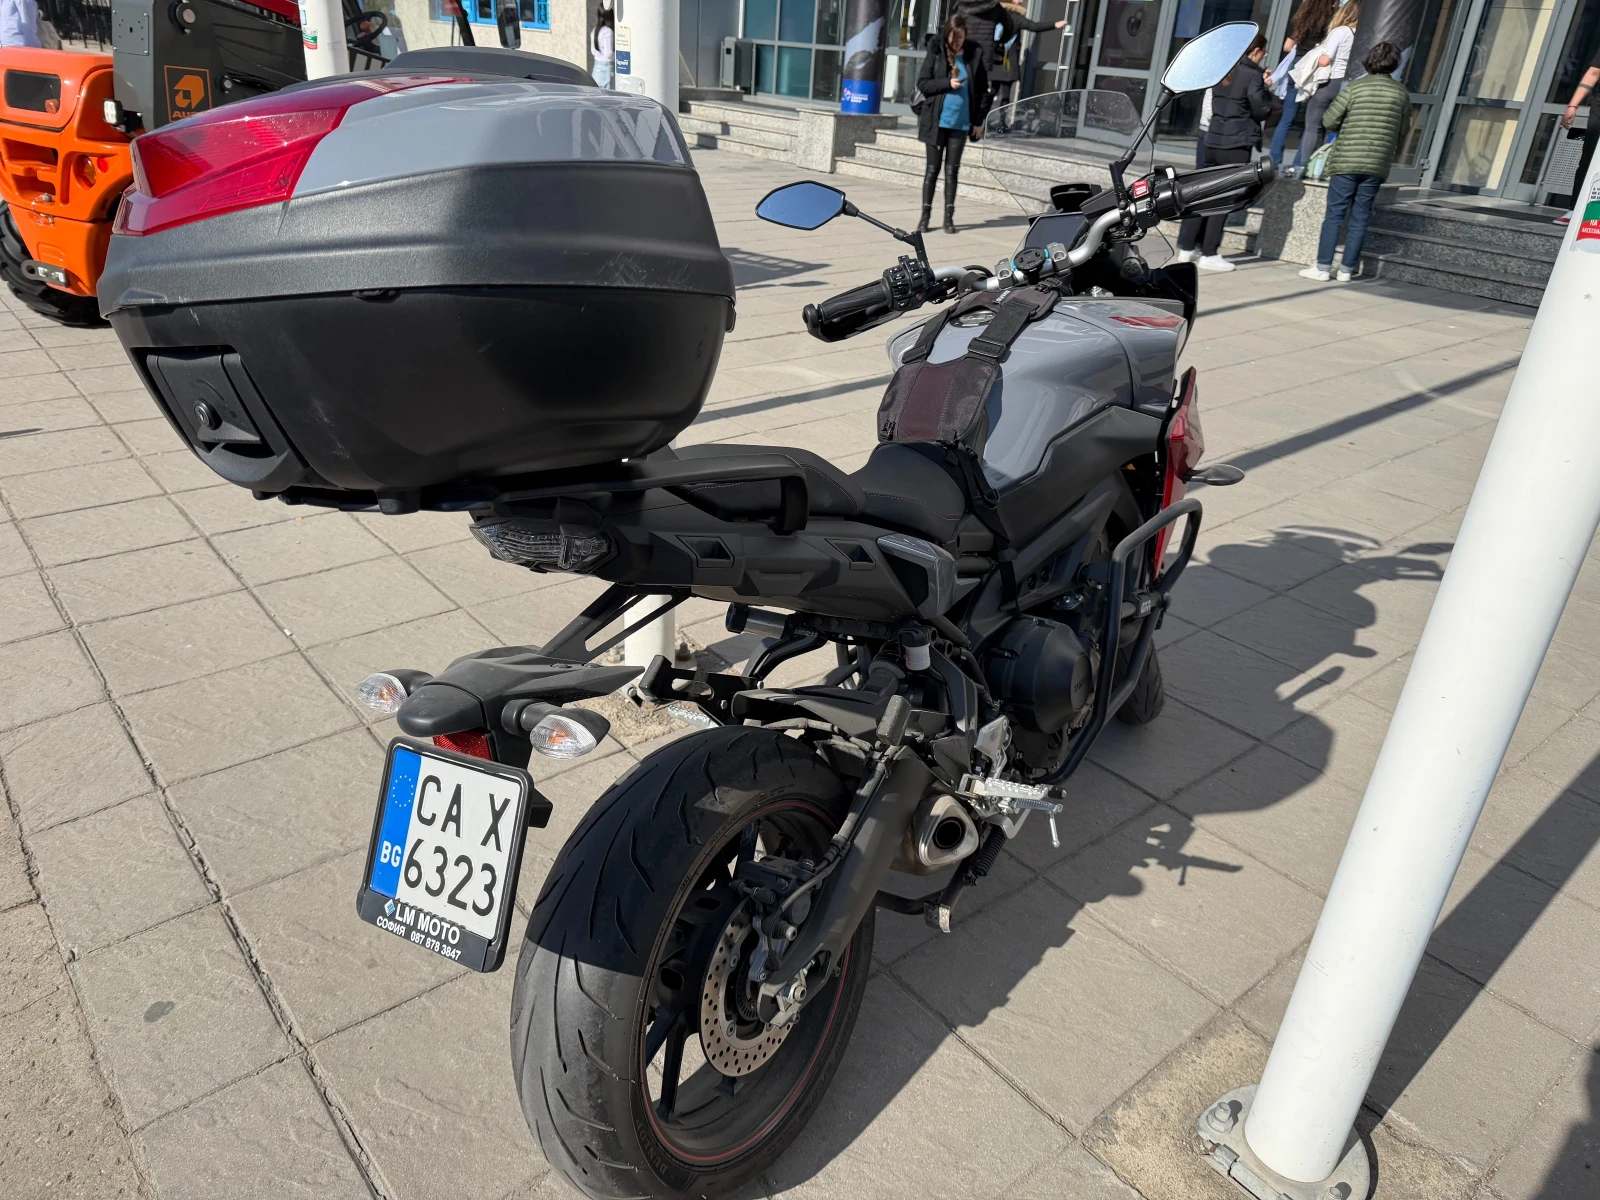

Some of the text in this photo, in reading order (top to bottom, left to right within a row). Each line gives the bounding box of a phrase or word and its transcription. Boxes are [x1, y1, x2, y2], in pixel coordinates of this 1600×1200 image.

[417, 774, 511, 852] CA X
[380, 841, 402, 868] BG
[404, 838, 497, 916] 6323
[376, 916, 461, 961] СОФИЯ 087 878 3847
[395, 903, 460, 944] LM MOTO
